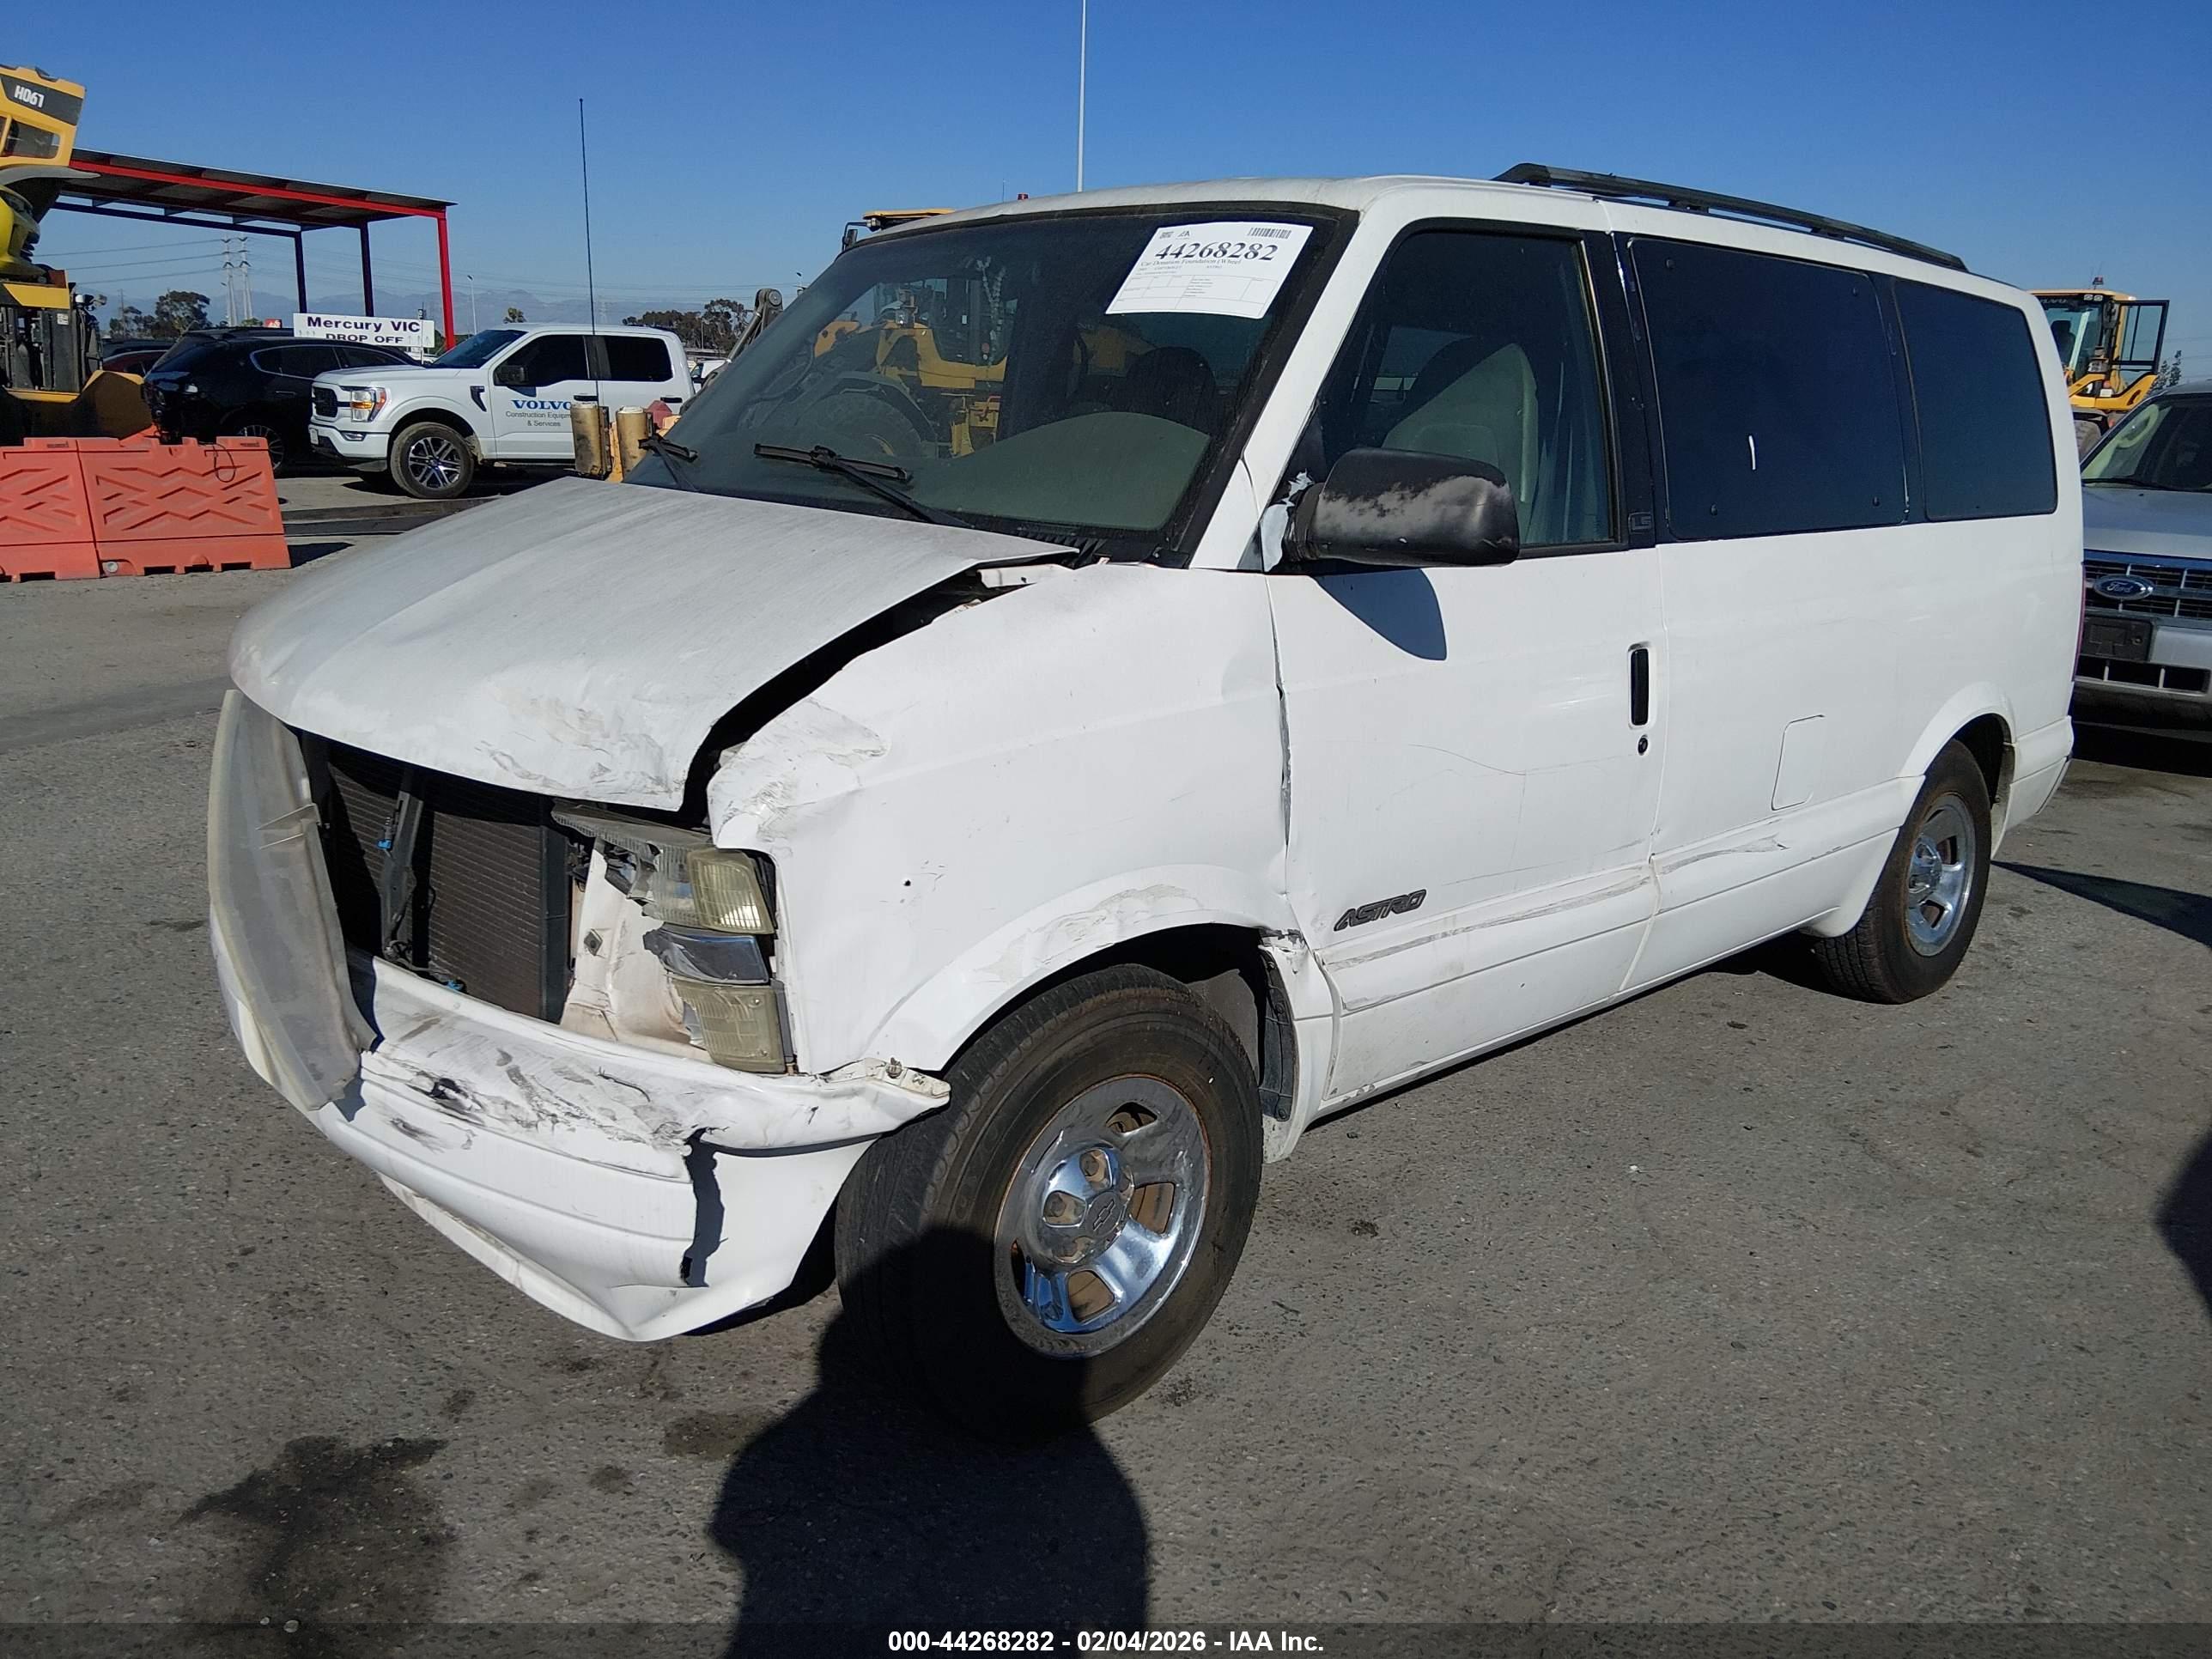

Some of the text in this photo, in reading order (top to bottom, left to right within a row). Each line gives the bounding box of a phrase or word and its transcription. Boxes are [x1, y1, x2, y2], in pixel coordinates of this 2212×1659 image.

[1154, 241, 1279, 261] 44268282
[307, 316, 421, 333] Mercury VIC
[325, 333, 368, 343] DROP
[2106, 580, 2134, 592] Ford
[1334, 889, 1427, 932] ASTRO
